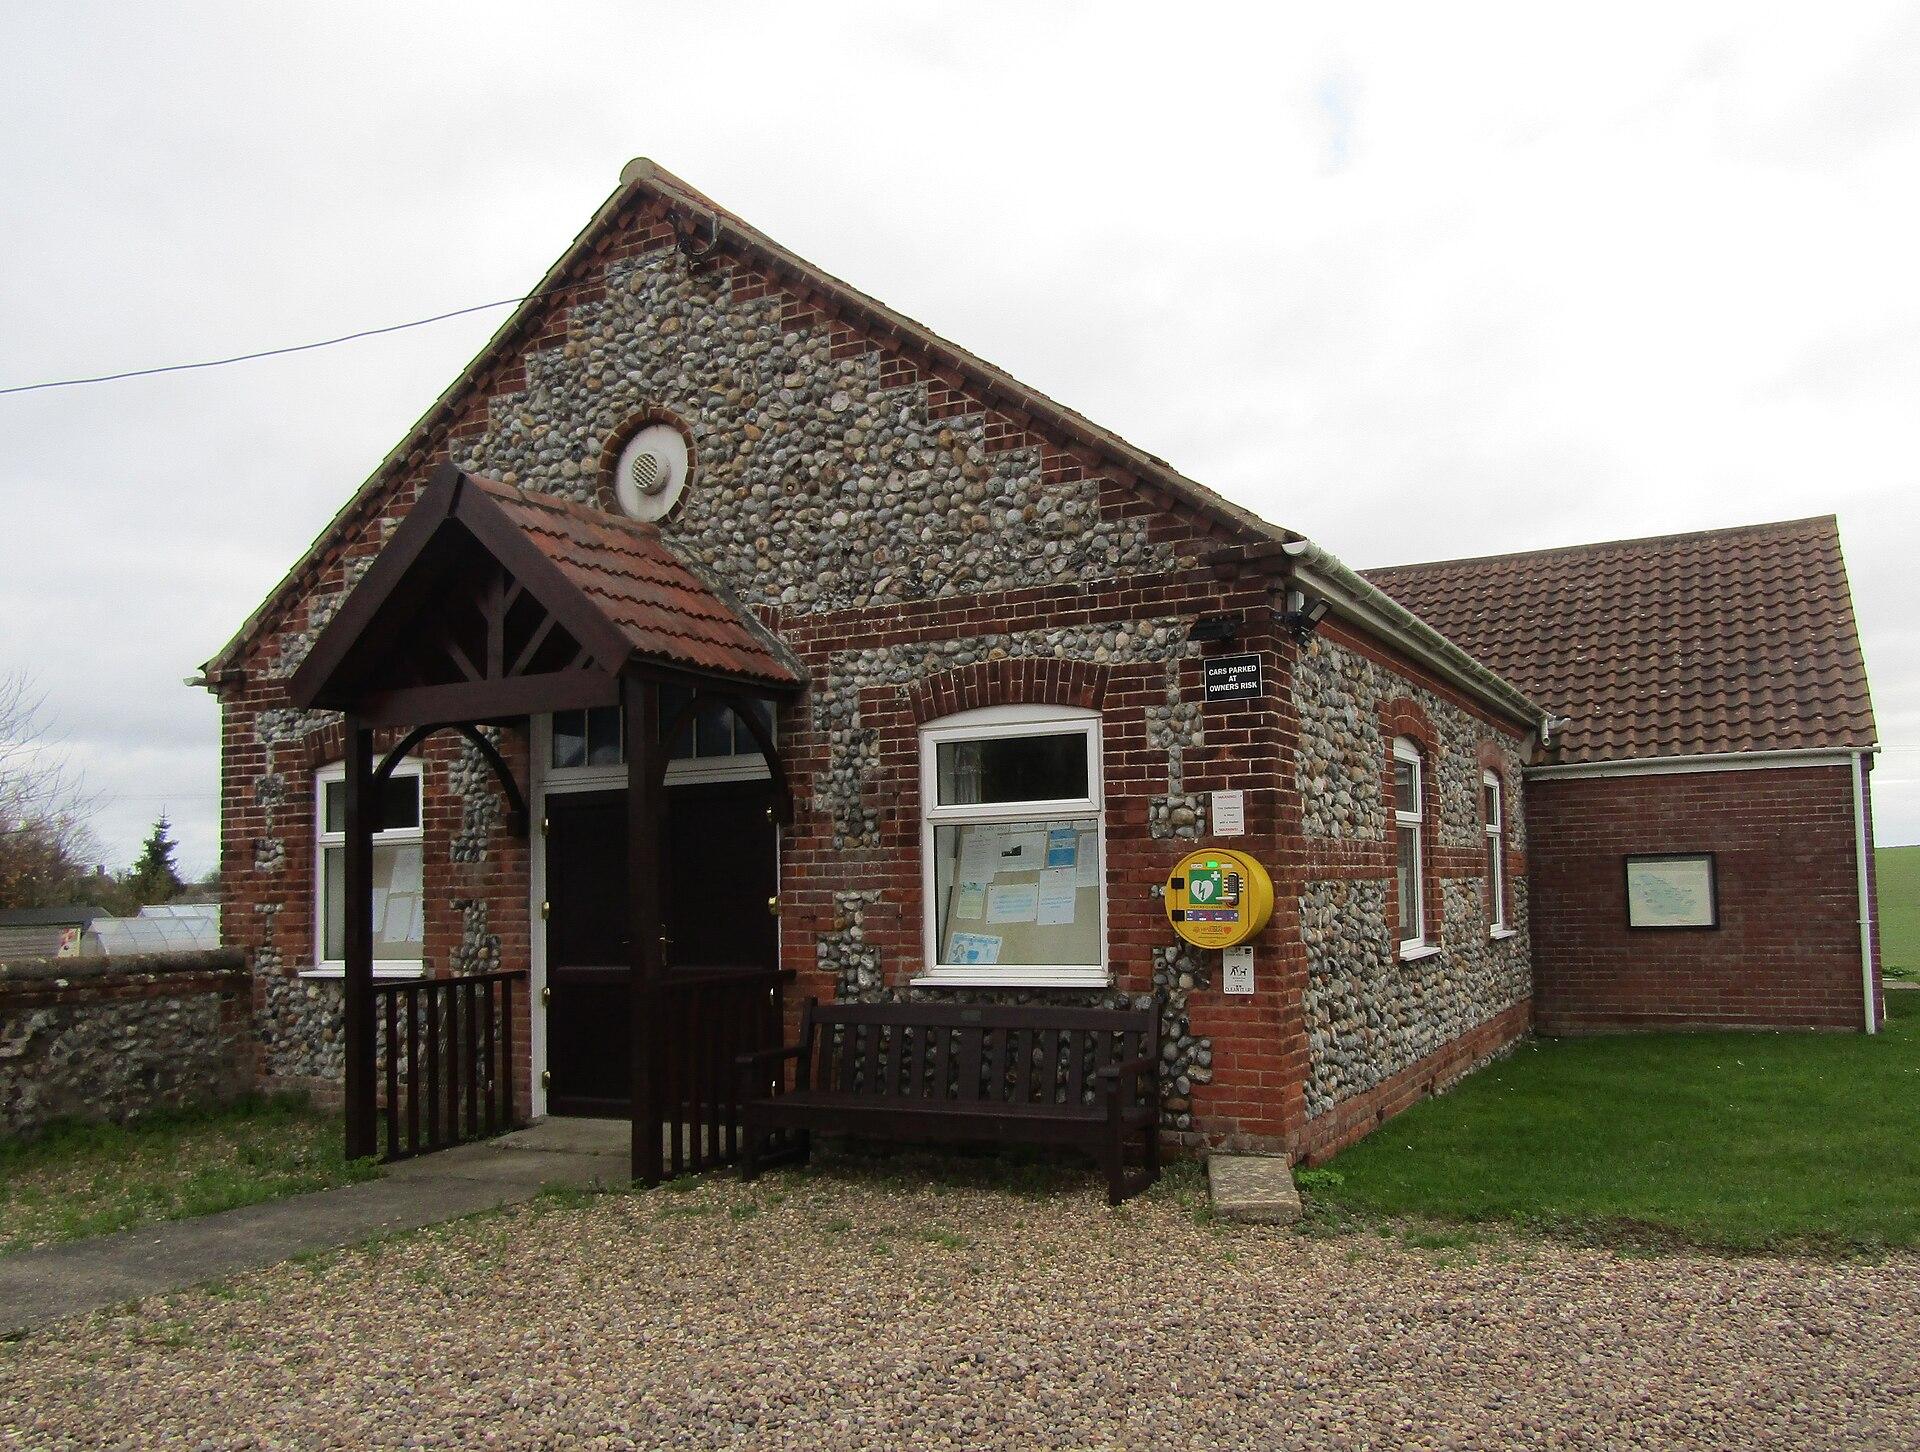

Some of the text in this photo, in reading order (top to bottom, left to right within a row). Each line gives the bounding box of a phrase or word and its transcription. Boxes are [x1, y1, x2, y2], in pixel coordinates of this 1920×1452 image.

[1209, 665, 1256, 676] CARS PARKED
[1210, 681, 1257, 692] OWNERS RISK
